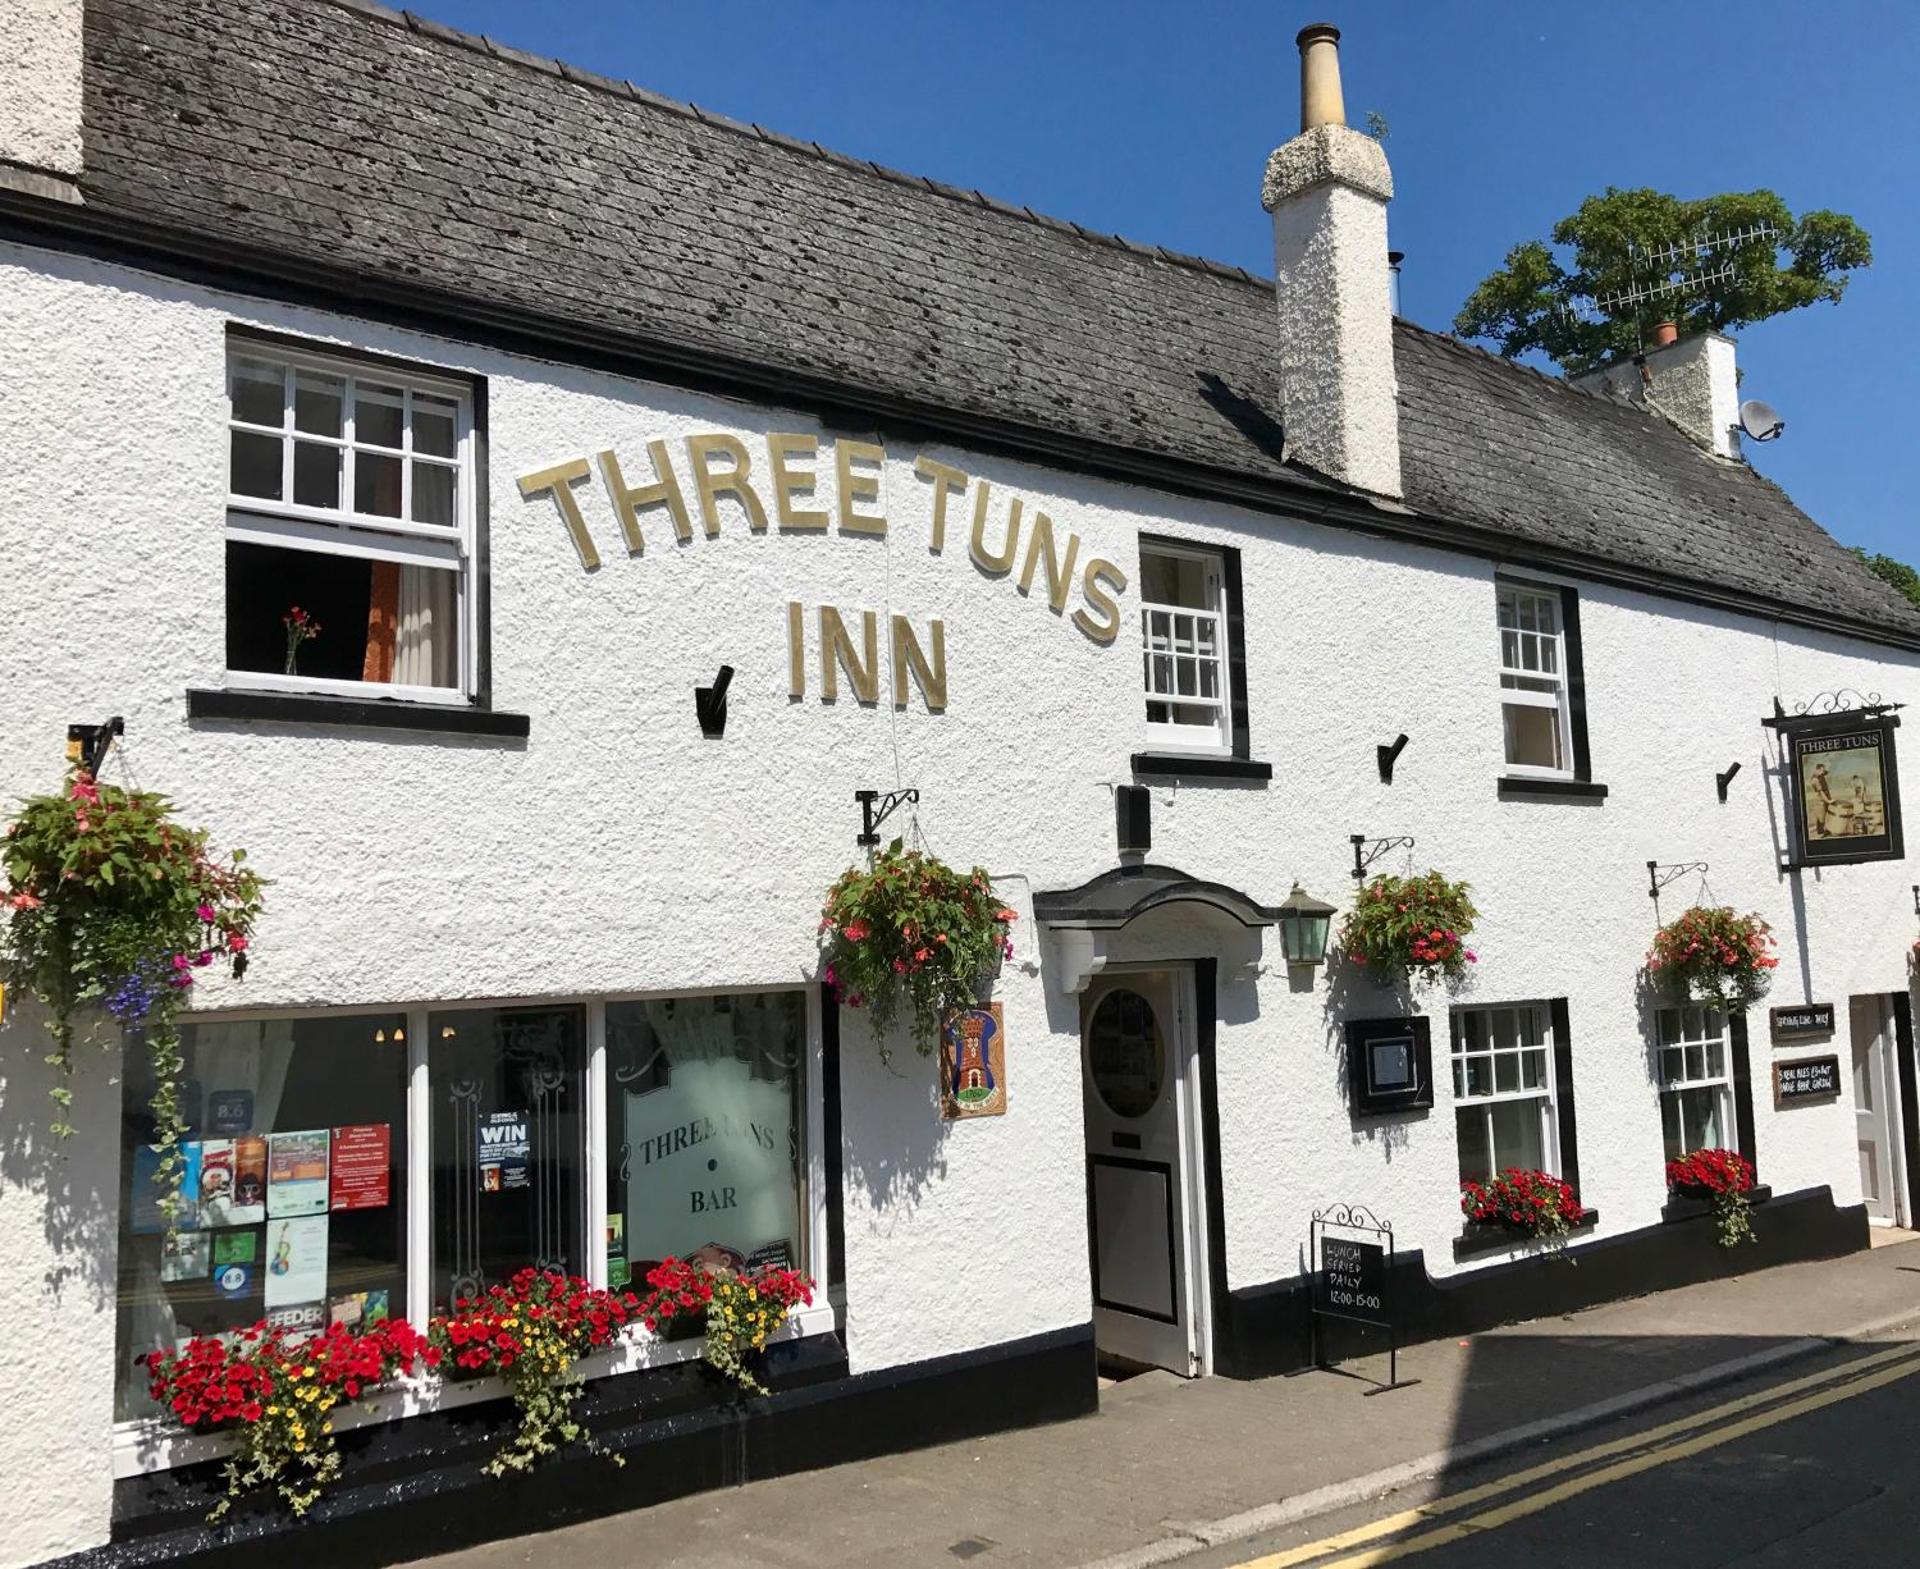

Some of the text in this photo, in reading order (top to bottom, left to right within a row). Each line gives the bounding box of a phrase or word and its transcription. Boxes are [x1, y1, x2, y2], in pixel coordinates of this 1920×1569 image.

[516, 431, 1127, 645] THREE TUNS
[788, 600, 948, 712] INN
[1801, 735, 1879, 753] THREE TUNS
[481, 1124, 526, 1144] WIN
[639, 1116, 717, 1165] THREE
[690, 1187, 738, 1213] BAR
[1326, 1244, 1361, 1261] LUNCH
[1326, 1257, 1362, 1273] SERVED
[1330, 1272, 1362, 1289] DAILY
[267, 1306, 324, 1327] FEEDER
